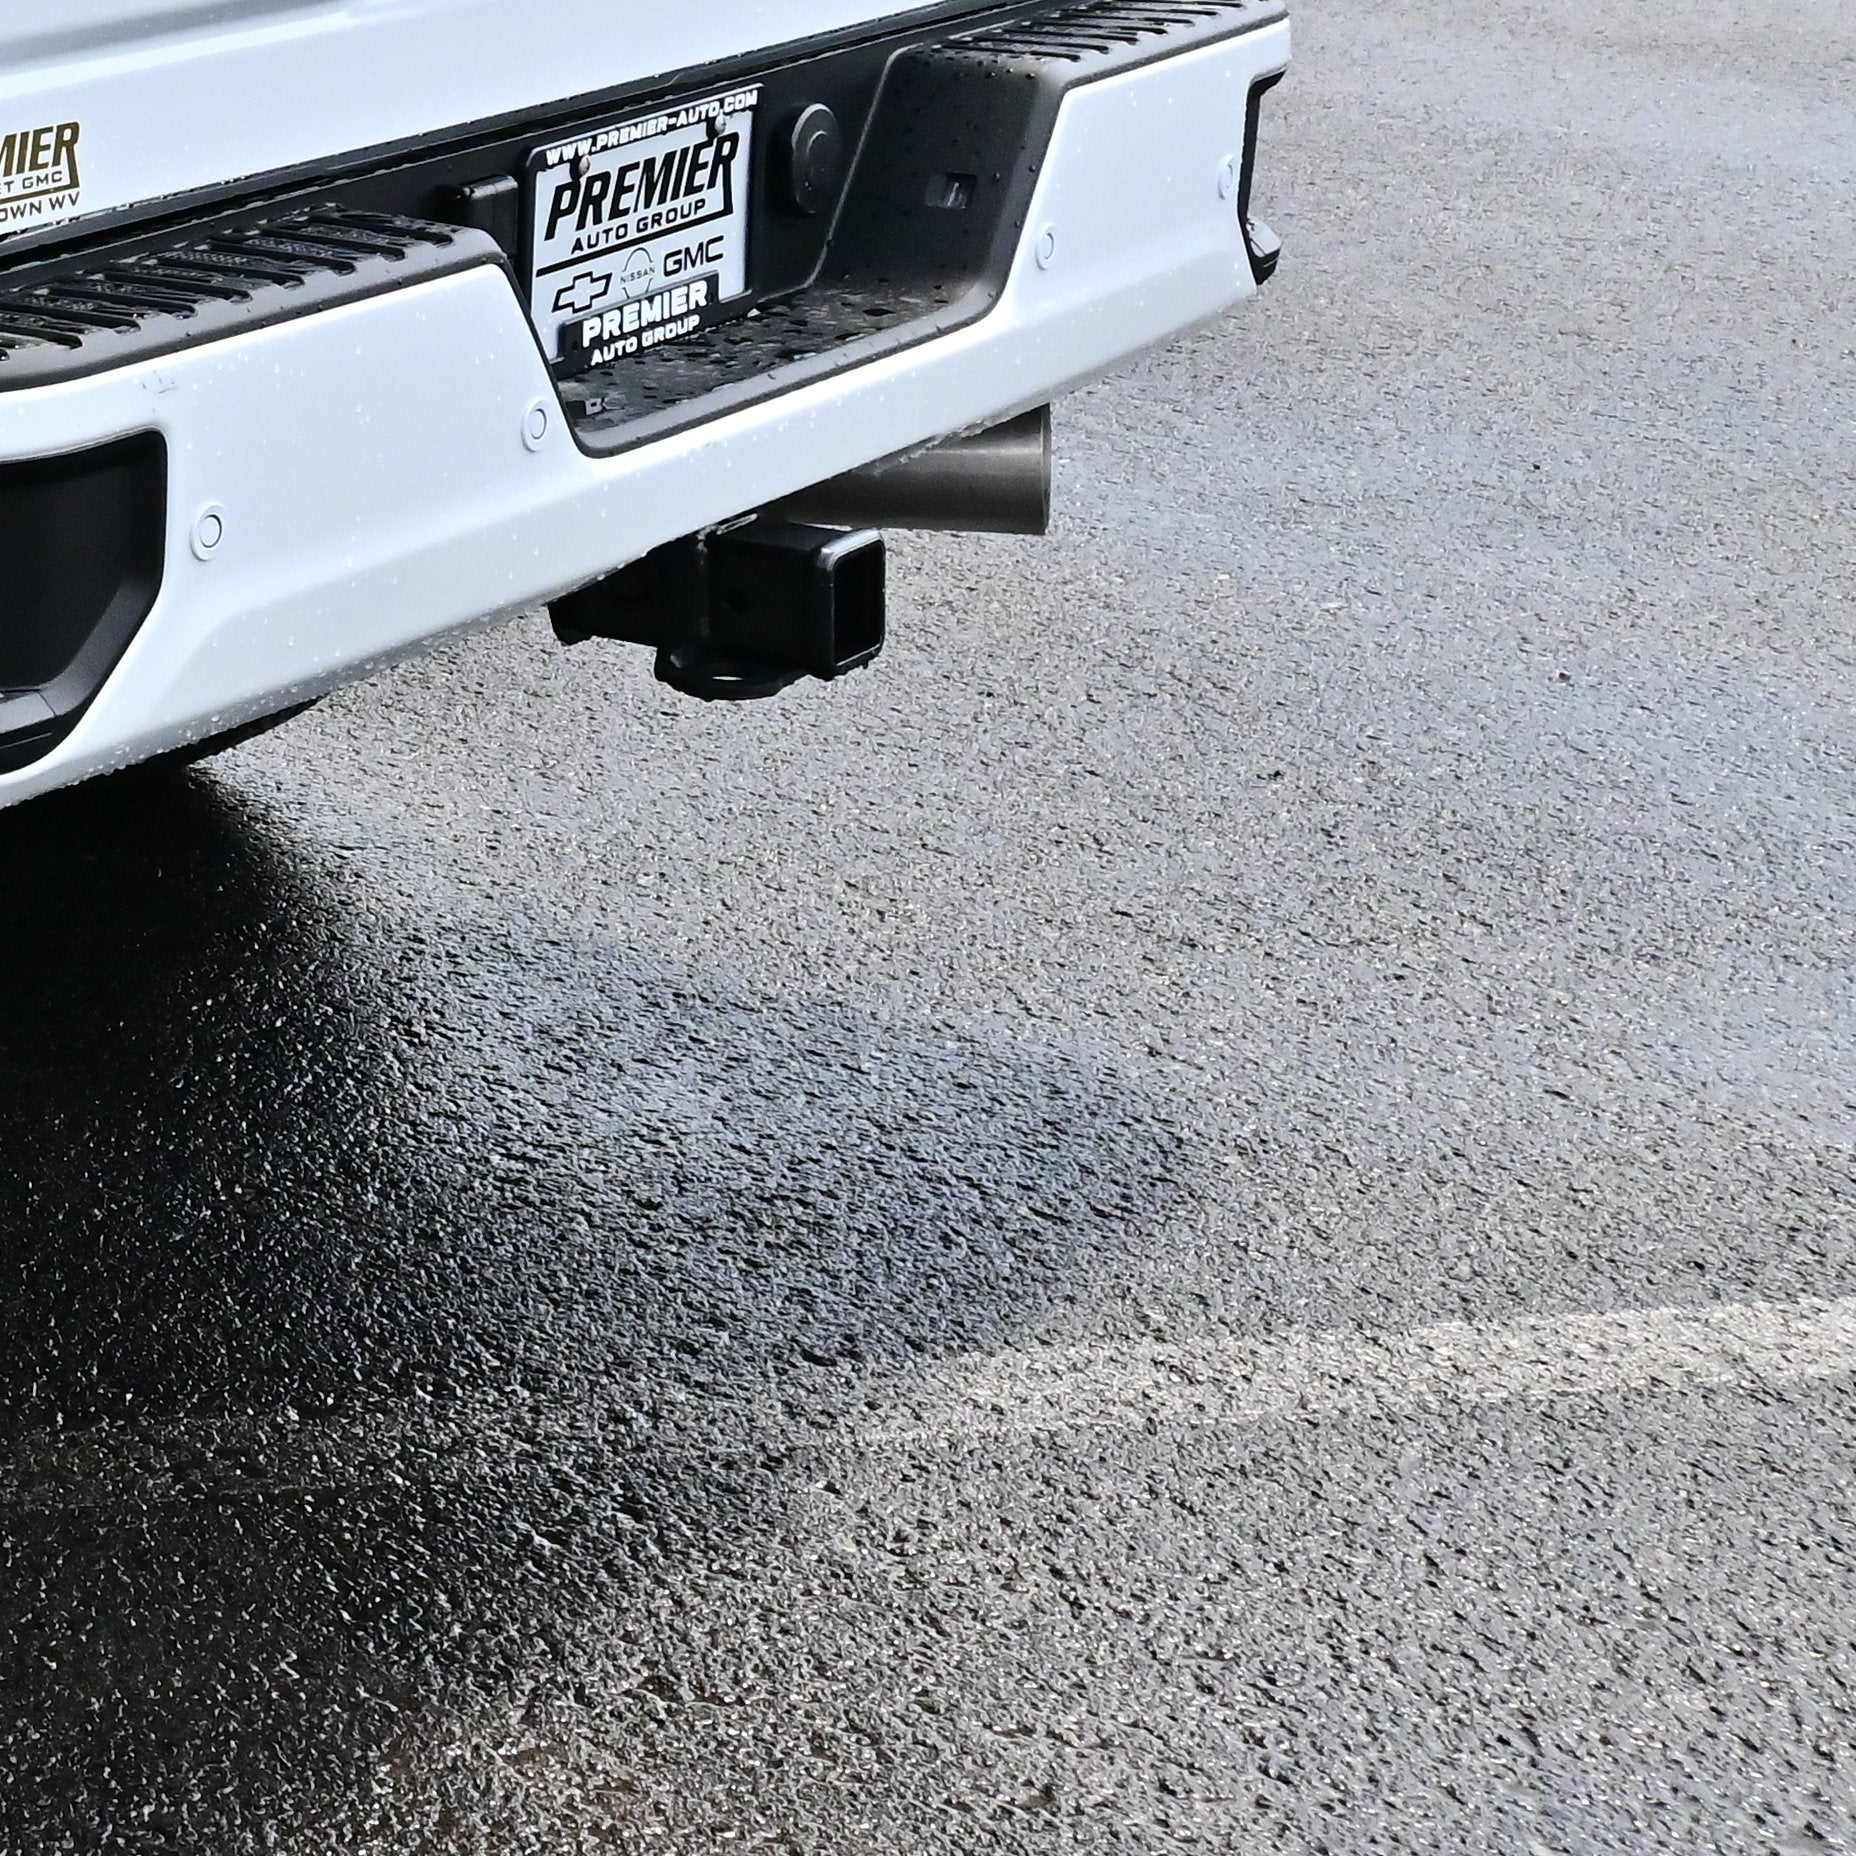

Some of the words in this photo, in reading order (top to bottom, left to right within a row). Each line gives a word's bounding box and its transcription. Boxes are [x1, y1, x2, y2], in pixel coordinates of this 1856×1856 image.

[545, 89, 758, 166] WWW.PREMIER-AUTO.COM
[22, 170, 63, 190] GMC
[48, 191, 81, 211] WV
[544, 131, 739, 241] PREMIER
[571, 223, 628, 255] AUTO
[637, 198, 706, 234] GROUP
[620, 265, 655, 284] NISSAN
[662, 235, 724, 277] GMC
[582, 279, 708, 348] PREMIER
[590, 335, 637, 366] AUTO
[641, 315, 700, 347] GROUP
